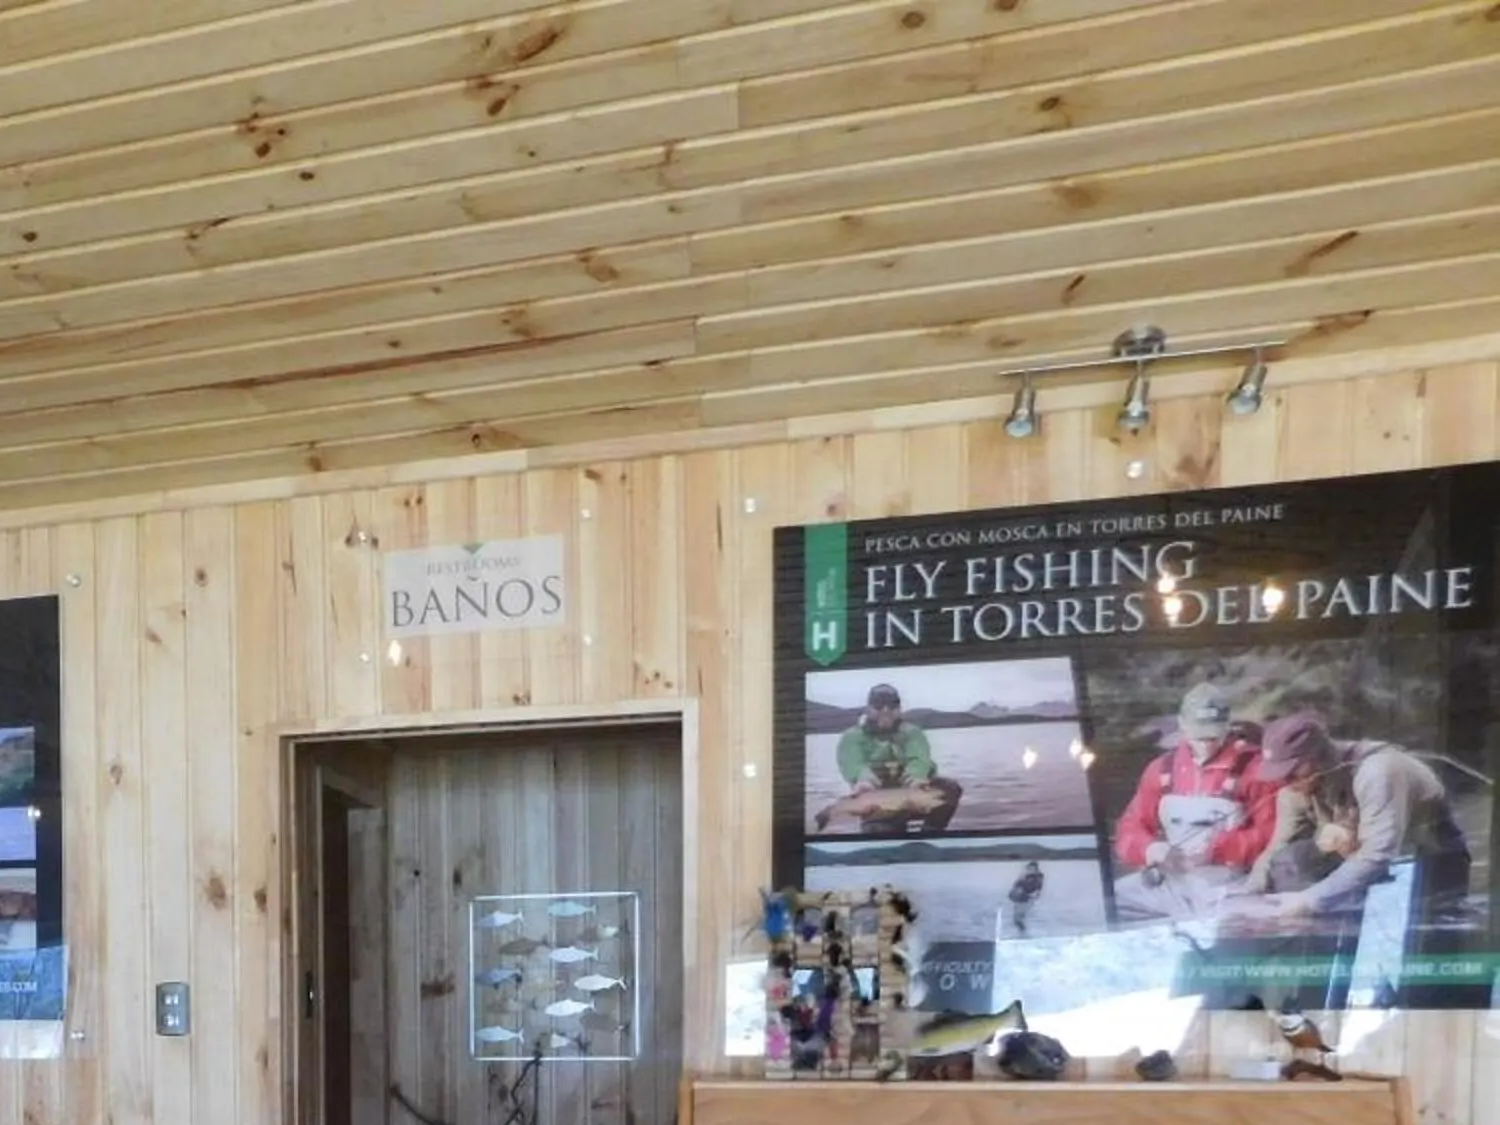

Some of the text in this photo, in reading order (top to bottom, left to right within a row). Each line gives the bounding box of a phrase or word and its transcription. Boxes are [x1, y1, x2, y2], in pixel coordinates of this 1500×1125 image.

[865, 503, 1285, 554] PESCA CON MOSCA EN TORRES DEL PAINE
[865, 560, 947, 603] FLY
[965, 540, 1196, 596] FISHING
[391, 574, 563, 628] BAÑOS
[866, 567, 1473, 649] IN TORRES DEL PAINE
[812, 620, 838, 651] H
